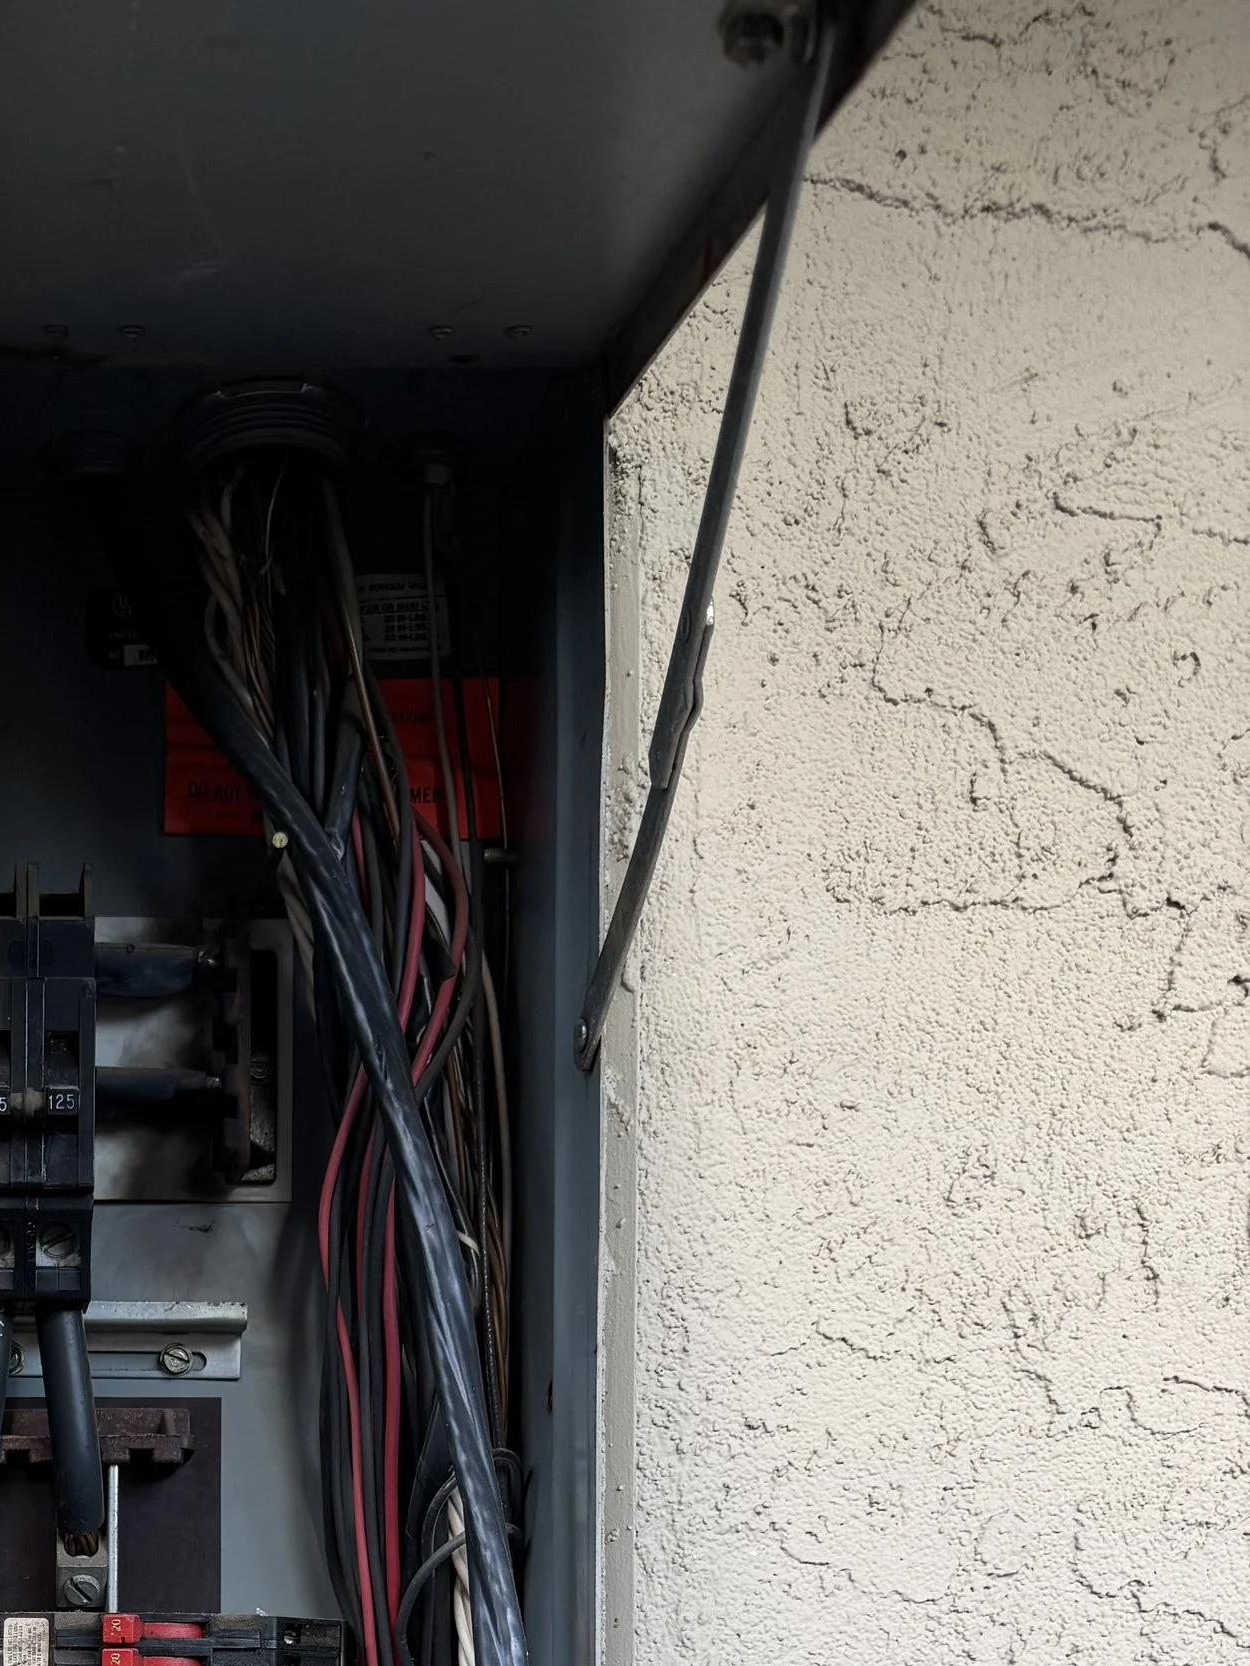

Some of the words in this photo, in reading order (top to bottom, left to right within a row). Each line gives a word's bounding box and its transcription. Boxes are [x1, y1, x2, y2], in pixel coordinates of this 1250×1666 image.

[48, 1094, 75, 1110] 125
[111, 1618, 121, 1632] 20
[110, 1652, 120, 1666] 20
